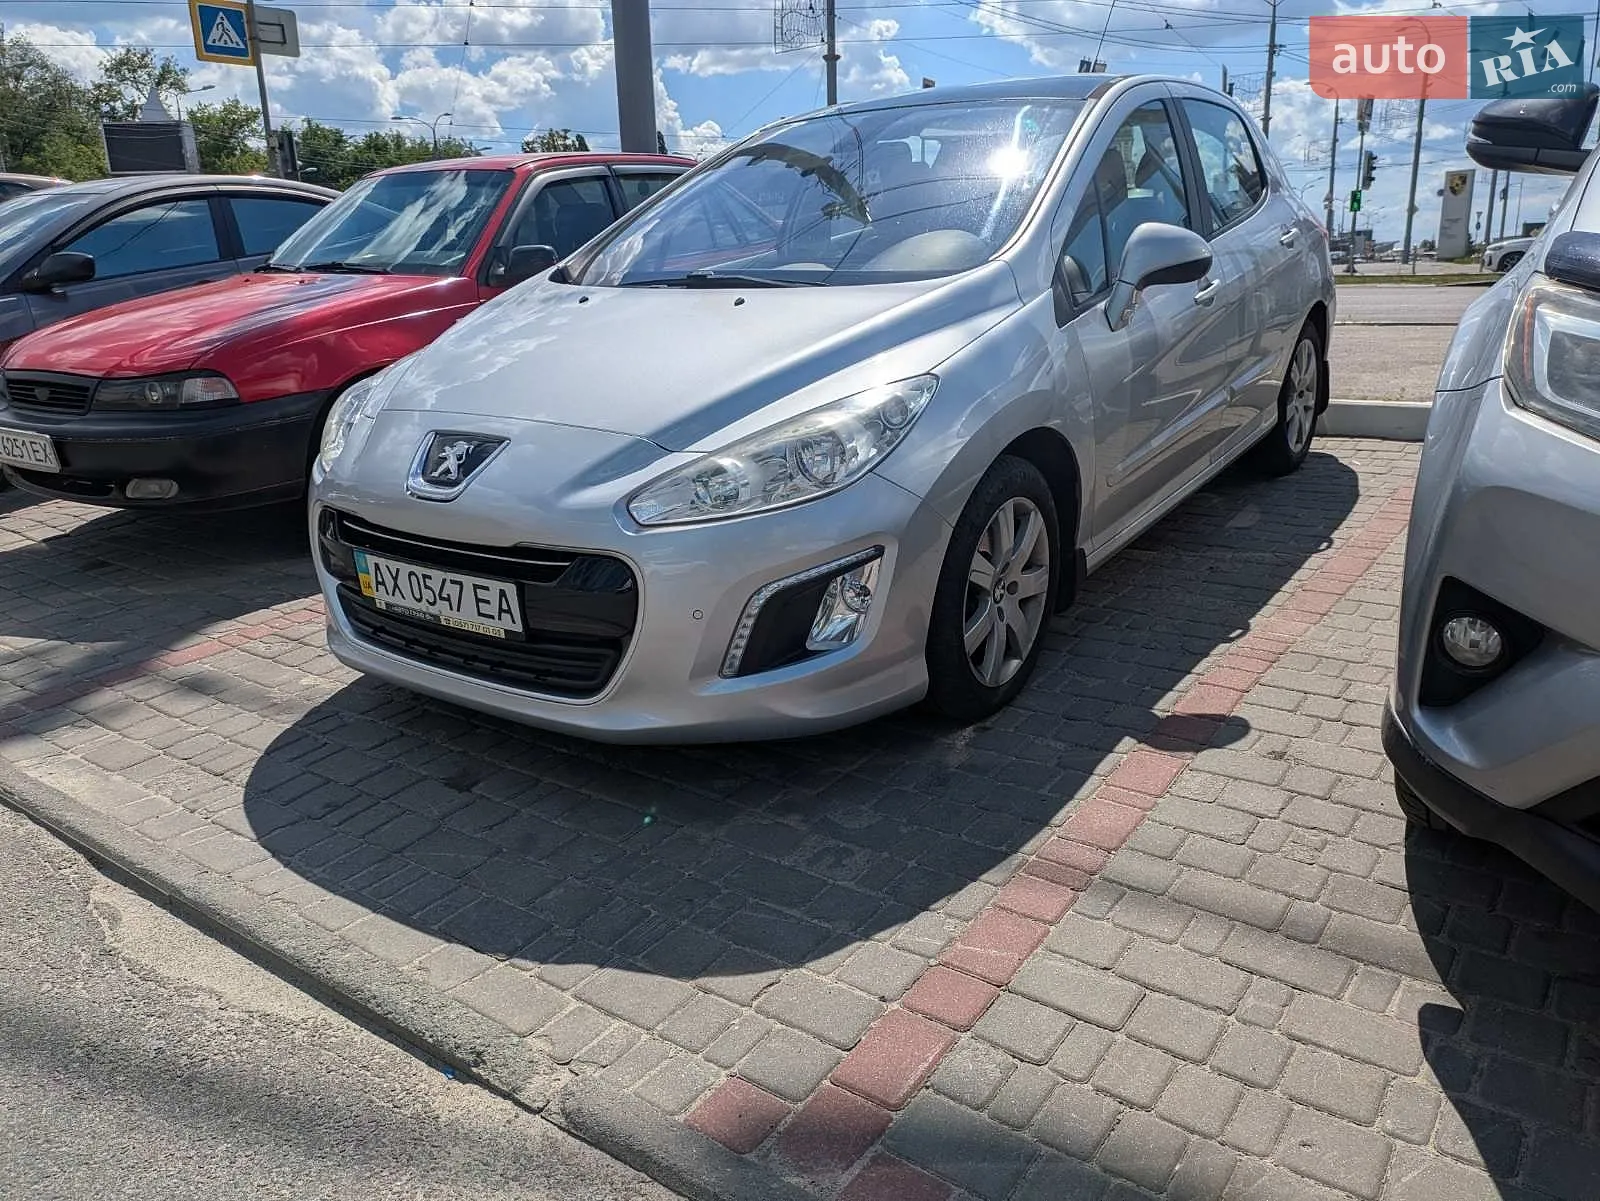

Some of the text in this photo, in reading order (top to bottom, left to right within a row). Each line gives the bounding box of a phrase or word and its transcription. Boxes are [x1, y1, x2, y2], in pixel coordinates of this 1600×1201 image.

[29, 440, 53, 465] EX
[362, 579, 373, 593] UA
[373, 562, 516, 625] AX 0547 EA
